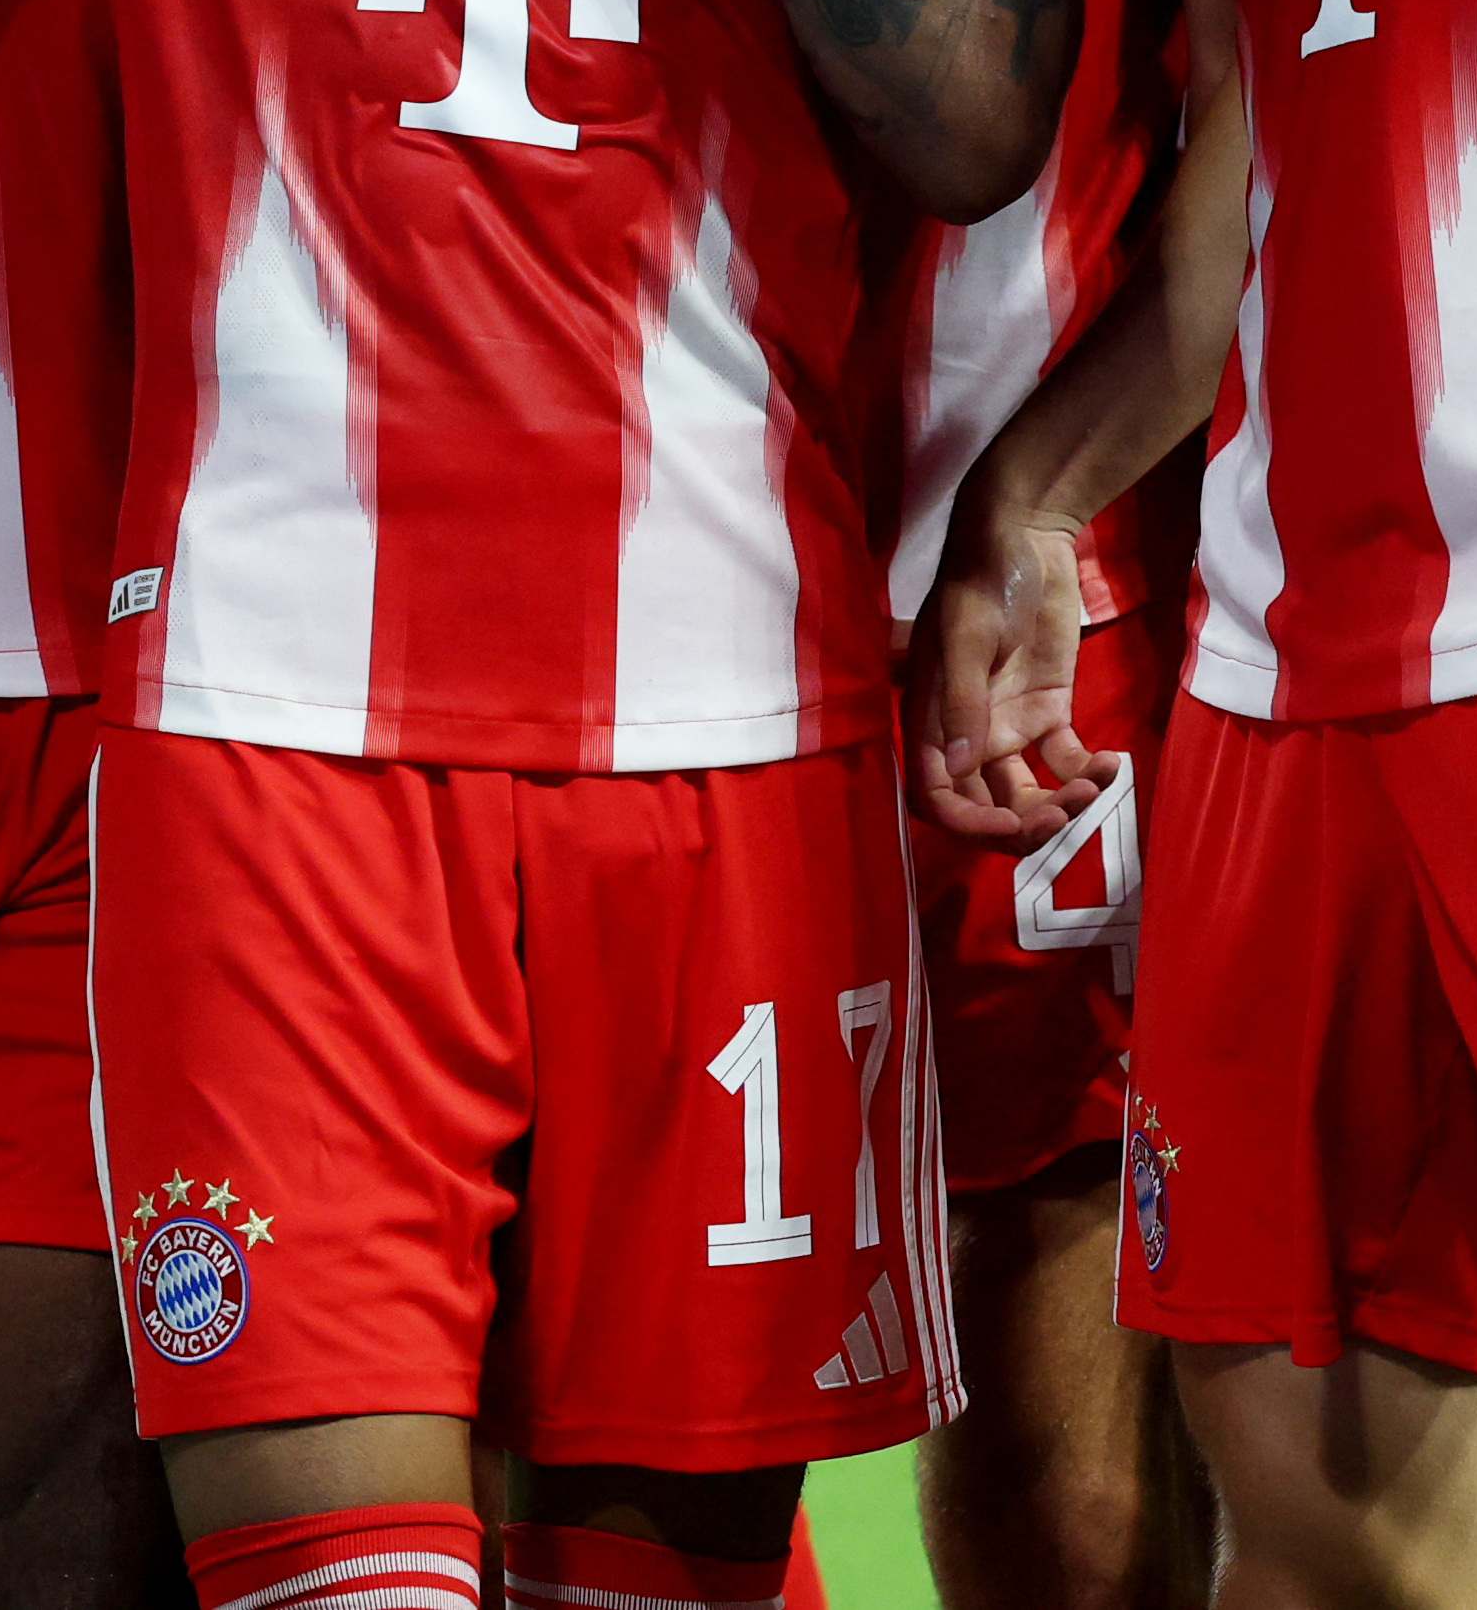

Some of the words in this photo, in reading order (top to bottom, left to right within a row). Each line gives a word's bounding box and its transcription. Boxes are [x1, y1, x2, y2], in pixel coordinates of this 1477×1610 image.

[705, 979, 892, 1267] 17
[141, 1253, 159, 1287] FC
[159, 1227, 236, 1278] BAYERN
[145, 1299, 240, 1355] MÜNCHEN
